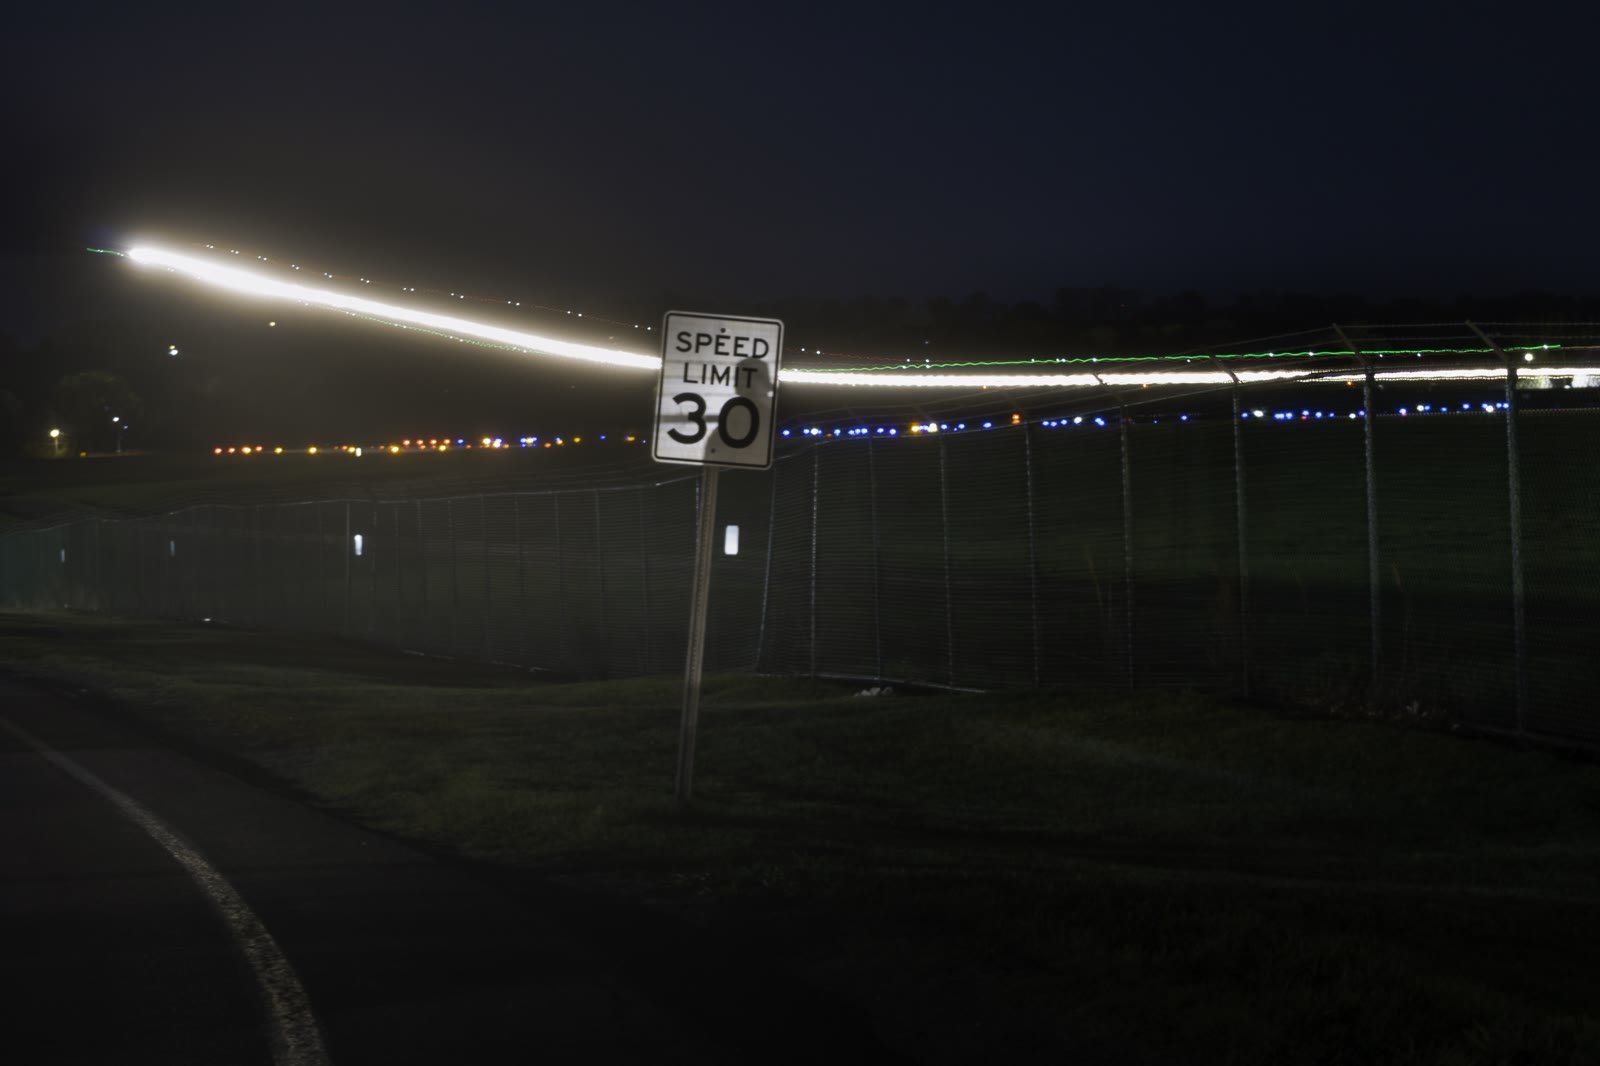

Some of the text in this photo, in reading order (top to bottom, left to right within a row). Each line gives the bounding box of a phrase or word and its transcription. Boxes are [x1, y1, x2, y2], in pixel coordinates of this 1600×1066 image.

[676, 331, 769, 359] SPEED
[683, 362, 758, 388] LIMIT
[667, 392, 760, 449] 30
